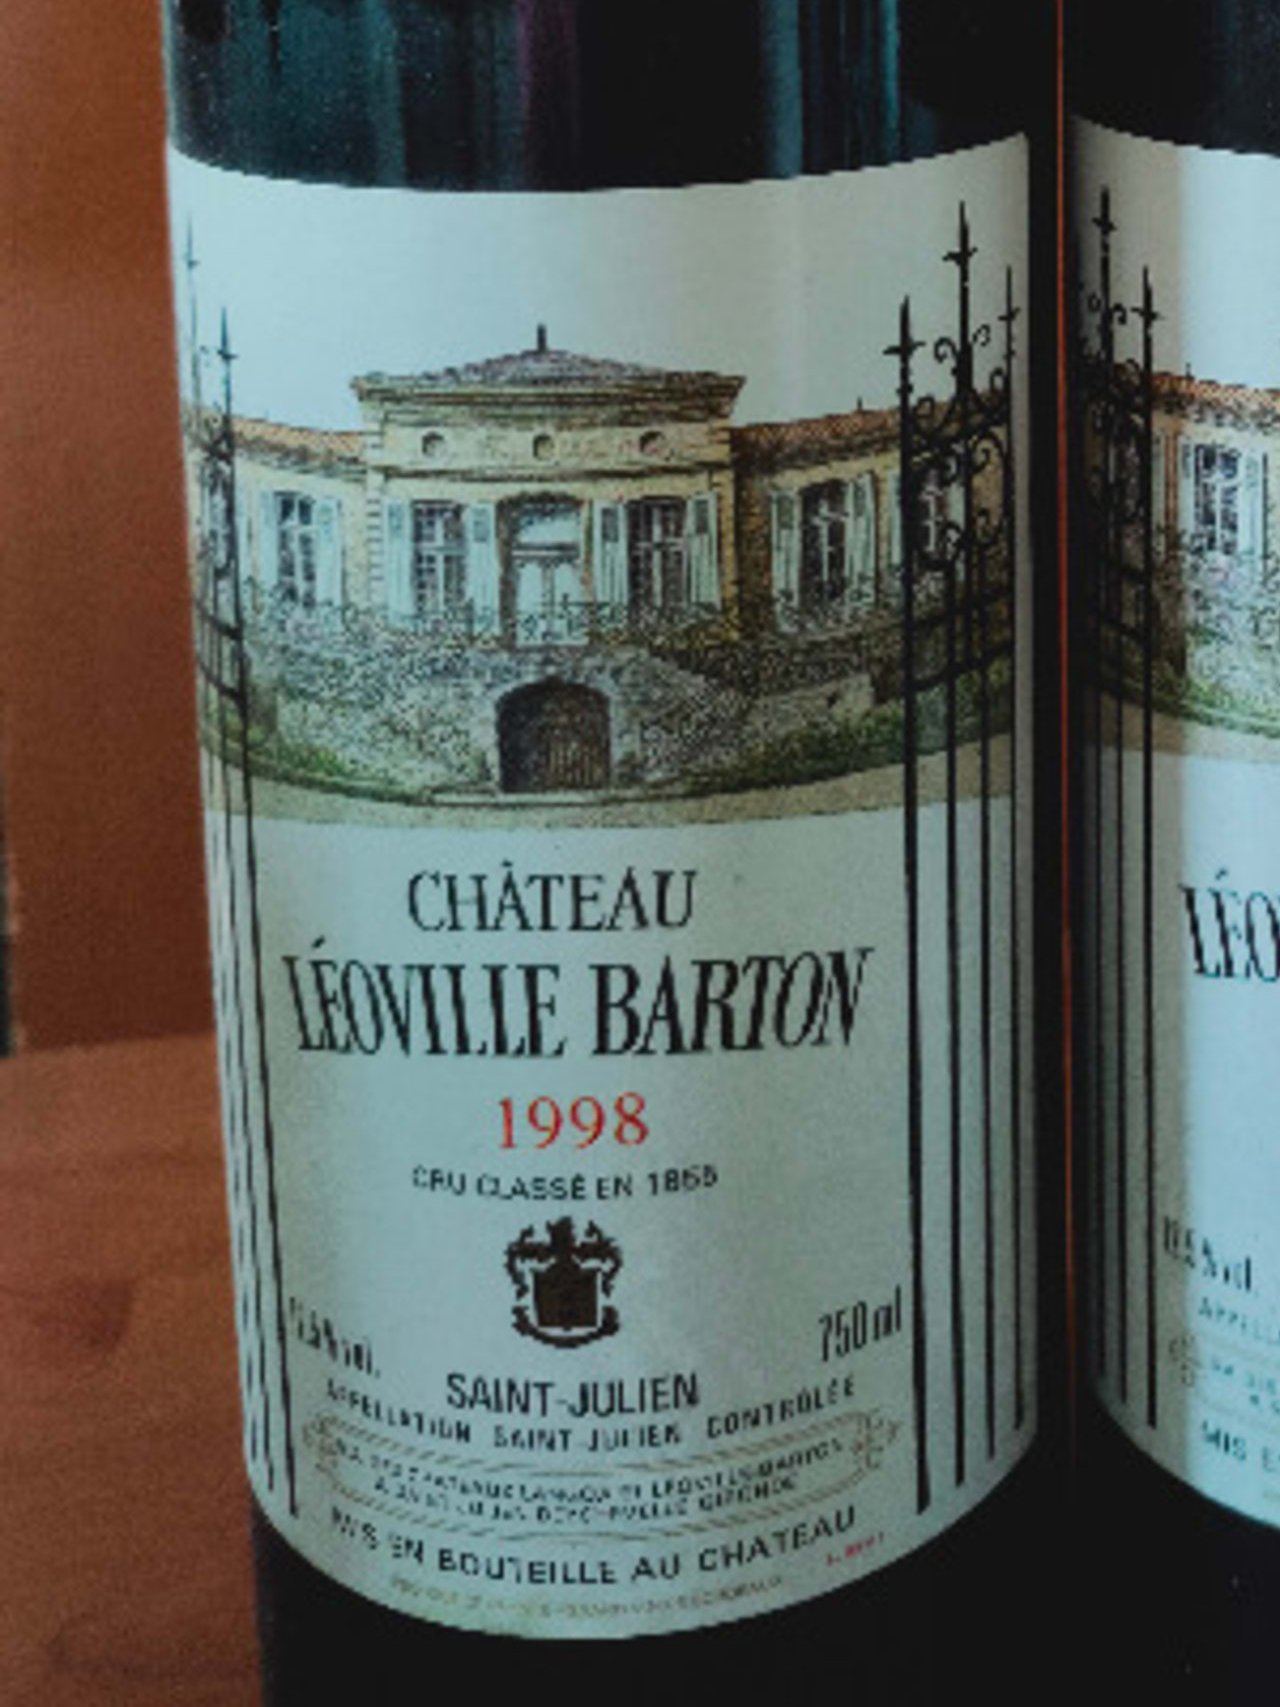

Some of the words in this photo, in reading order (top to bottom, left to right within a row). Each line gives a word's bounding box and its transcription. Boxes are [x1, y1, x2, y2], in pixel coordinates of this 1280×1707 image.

[408, 857, 697, 932] CHÂTEAU
[281, 935, 567, 1058] LÉOVILLE
[589, 946, 875, 1056] BARTON
[498, 1092, 649, 1149] 1998
[413, 1164, 466, 1196] CRU
[596, 1174, 633, 1200] EN
[438, 1547, 617, 1587] BOUTEILLE
[630, 1553, 680, 1583] AU
